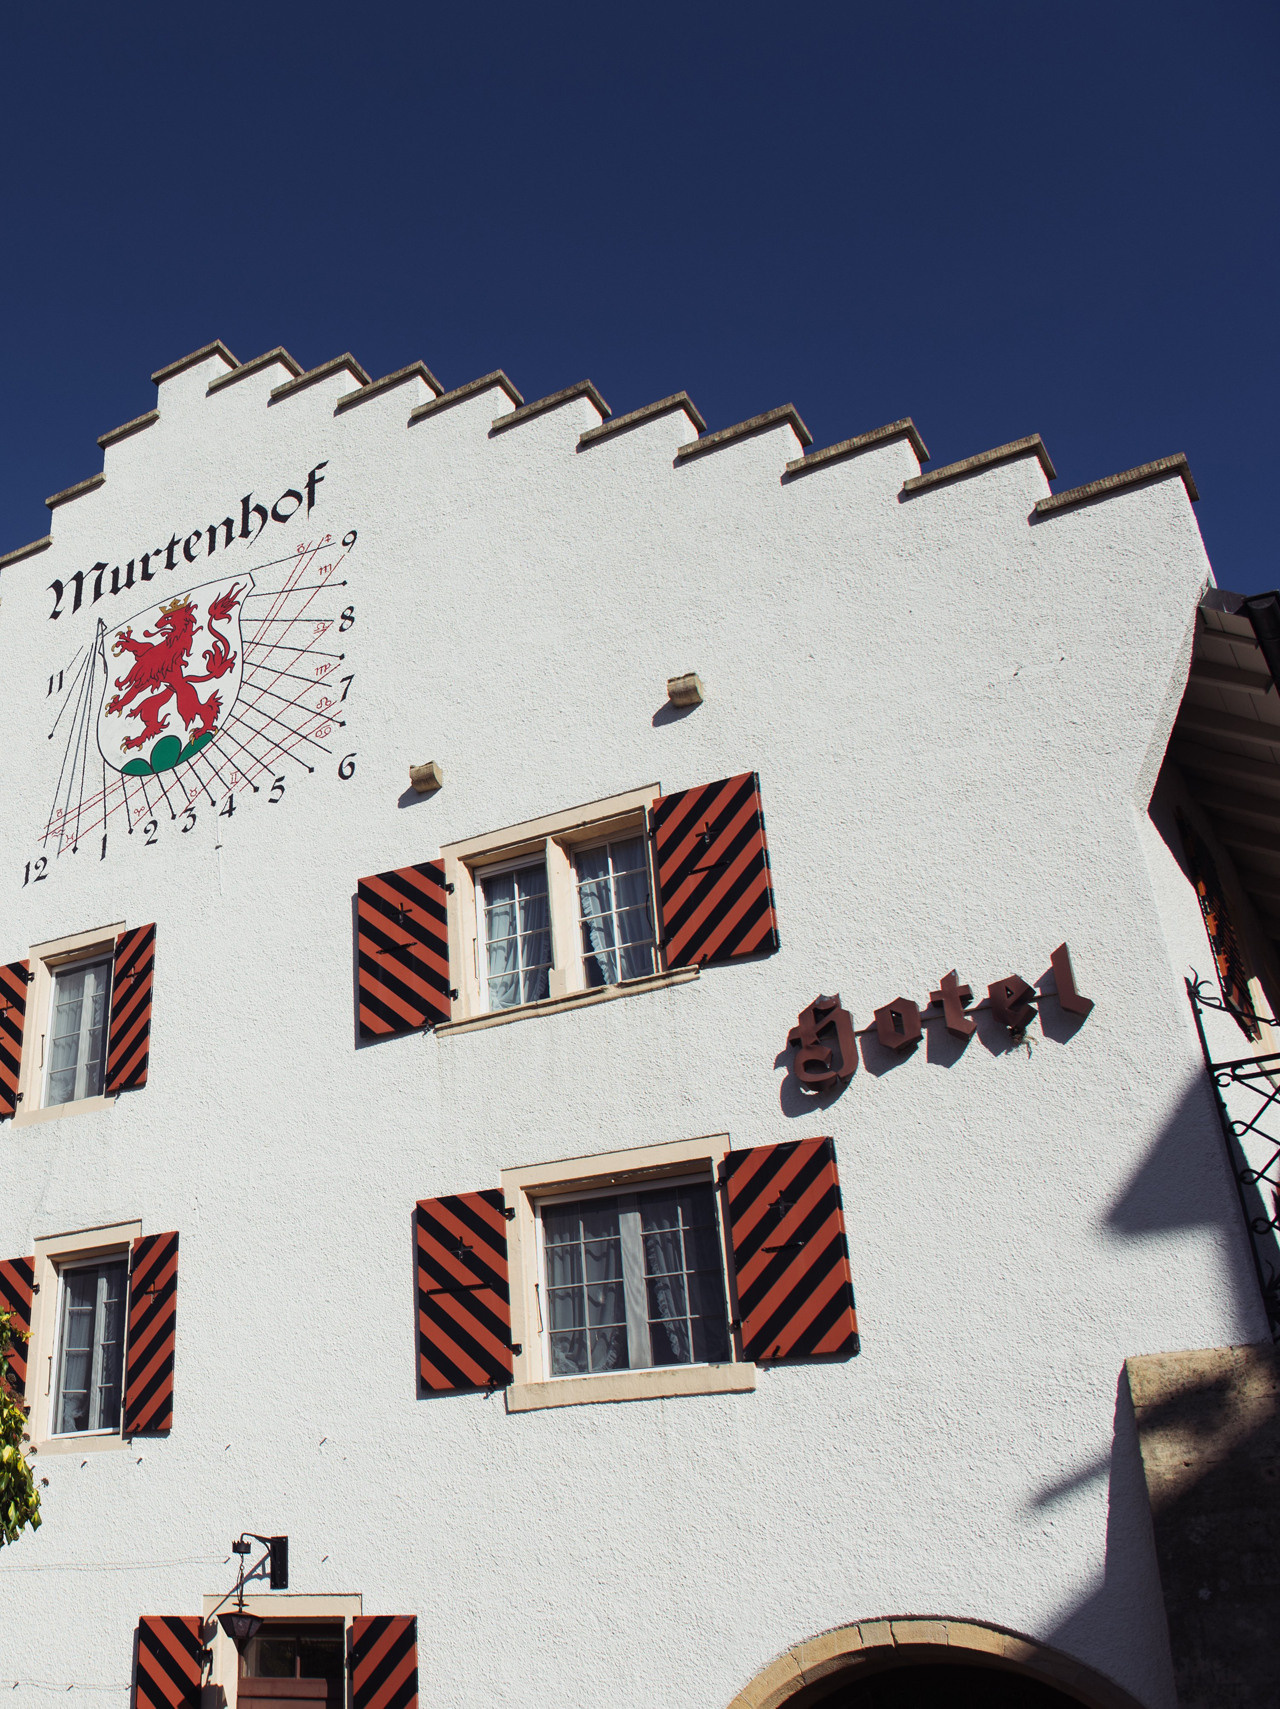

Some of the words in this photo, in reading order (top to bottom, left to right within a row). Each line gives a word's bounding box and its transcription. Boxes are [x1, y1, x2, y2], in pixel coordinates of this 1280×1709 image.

[48, 460, 329, 620] Murtenhof
[341, 529, 358, 553] 9
[338, 605, 355, 633] 8
[339, 673, 355, 703] 7
[338, 752, 357, 781] 6
[267, 775, 286, 804] 5
[181, 806, 197, 834] 3
[218, 793, 237, 819] 4
[99, 833, 108, 862] 1
[143, 819, 159, 847] 2
[22, 856, 49, 889] 12
